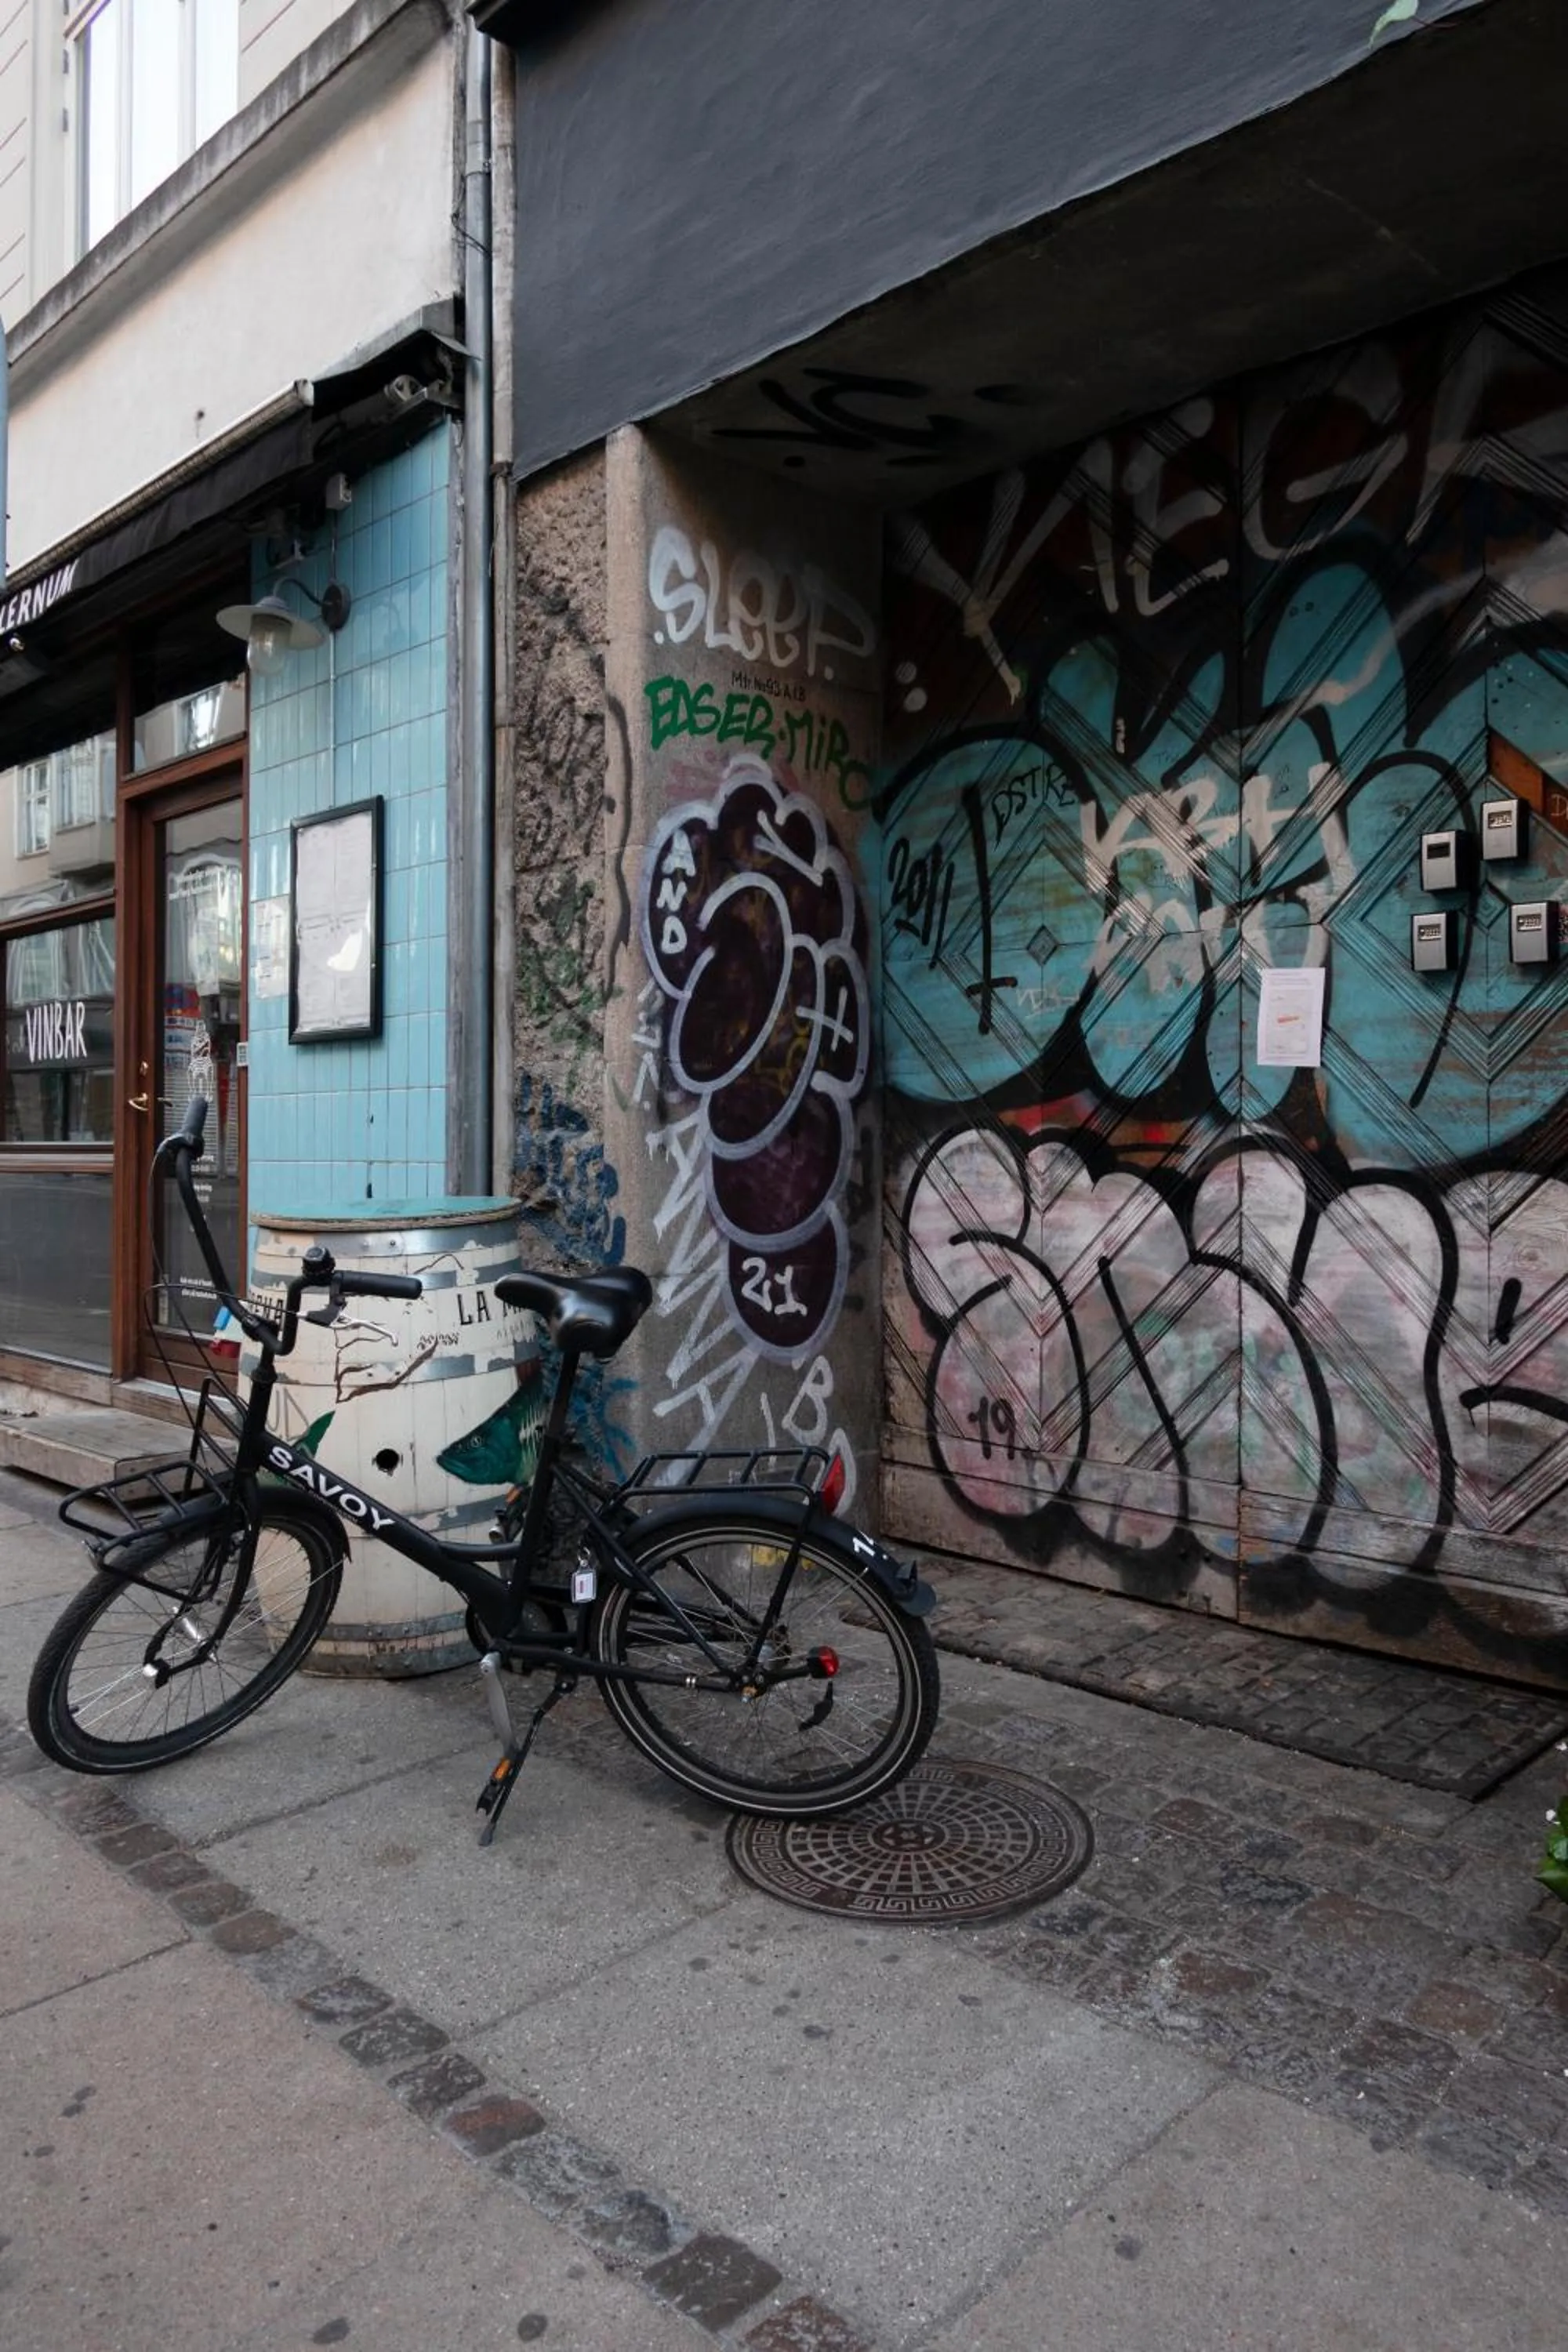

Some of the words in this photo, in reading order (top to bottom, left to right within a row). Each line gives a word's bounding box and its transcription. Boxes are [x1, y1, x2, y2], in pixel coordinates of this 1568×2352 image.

[26, 1000, 87, 1063] VINBAR
[740, 1256, 808, 1317] 21
[967, 1396, 1016, 1461] 19
[269, 1446, 395, 1530] SAVOY
